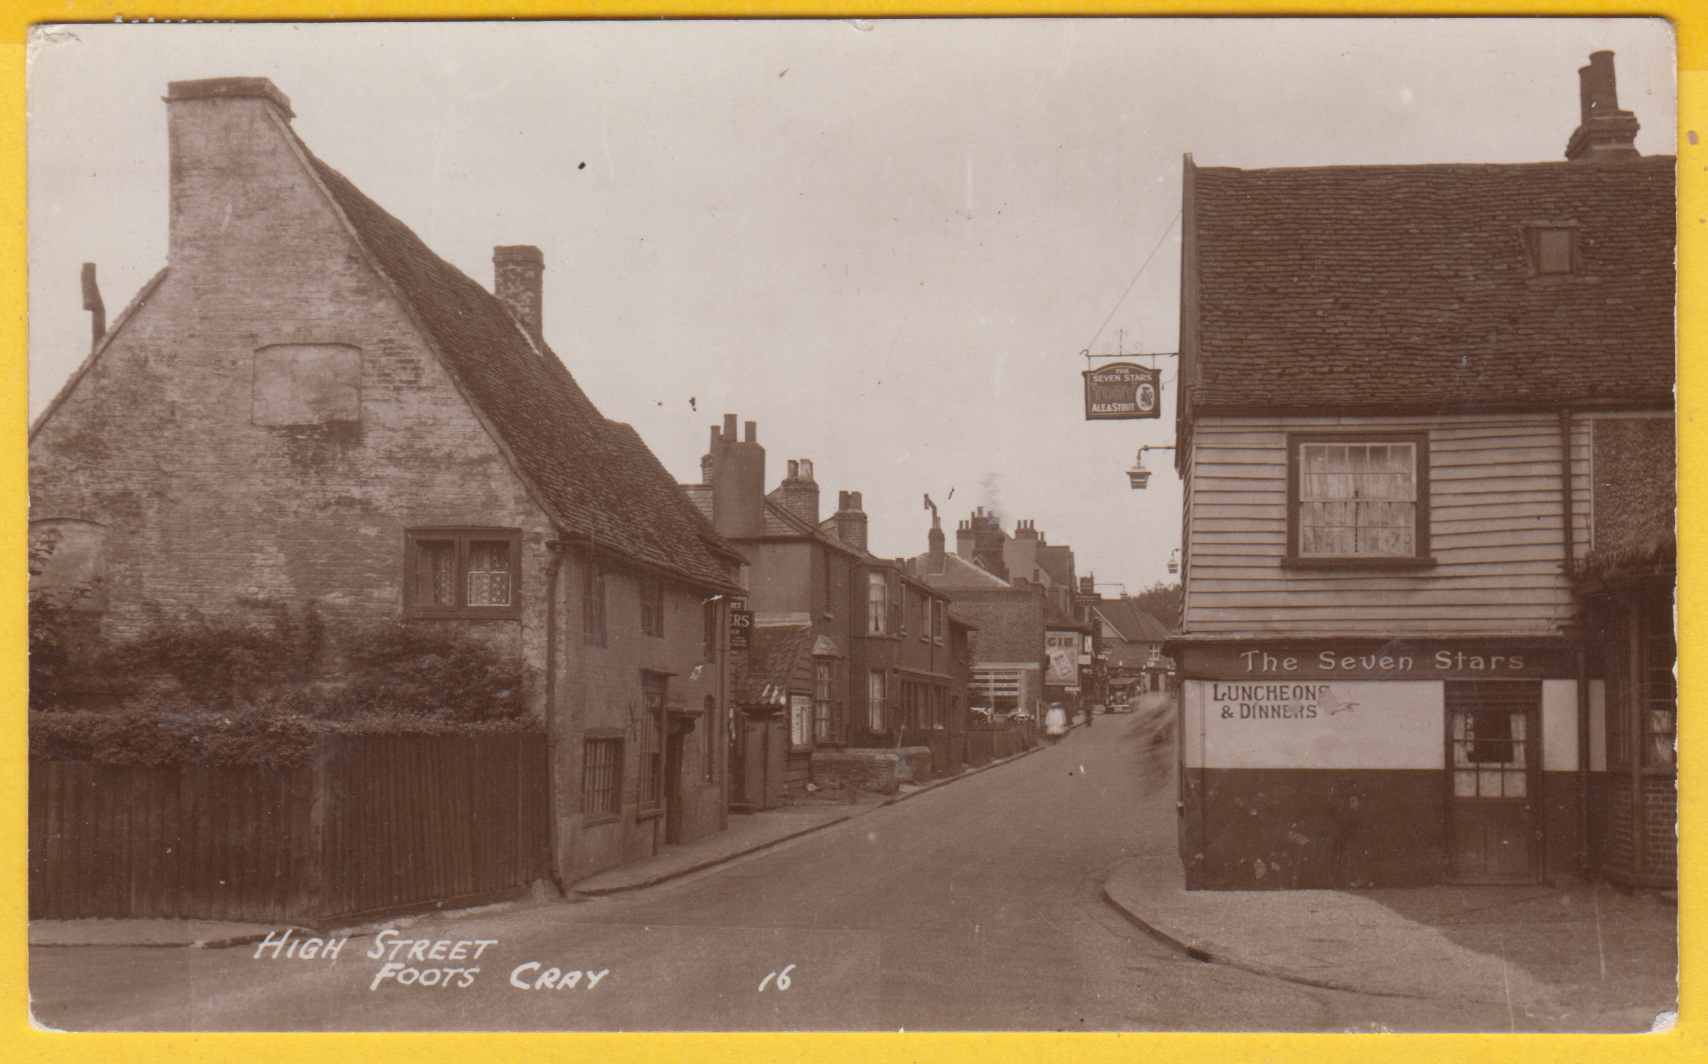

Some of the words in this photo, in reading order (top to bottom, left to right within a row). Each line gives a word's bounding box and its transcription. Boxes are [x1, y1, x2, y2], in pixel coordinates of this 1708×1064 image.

[1093, 374, 1121, 382] SEVEN
[1124, 374, 1152, 382] STARS
[1092, 385, 1136, 399] TOBY
[1240, 650, 1298, 672] The
[1318, 651, 1413, 671] Seven
[1435, 651, 1524, 671] Stars
[1221, 705, 1234, 719] &
[1239, 703, 1317, 719] DINNERS
